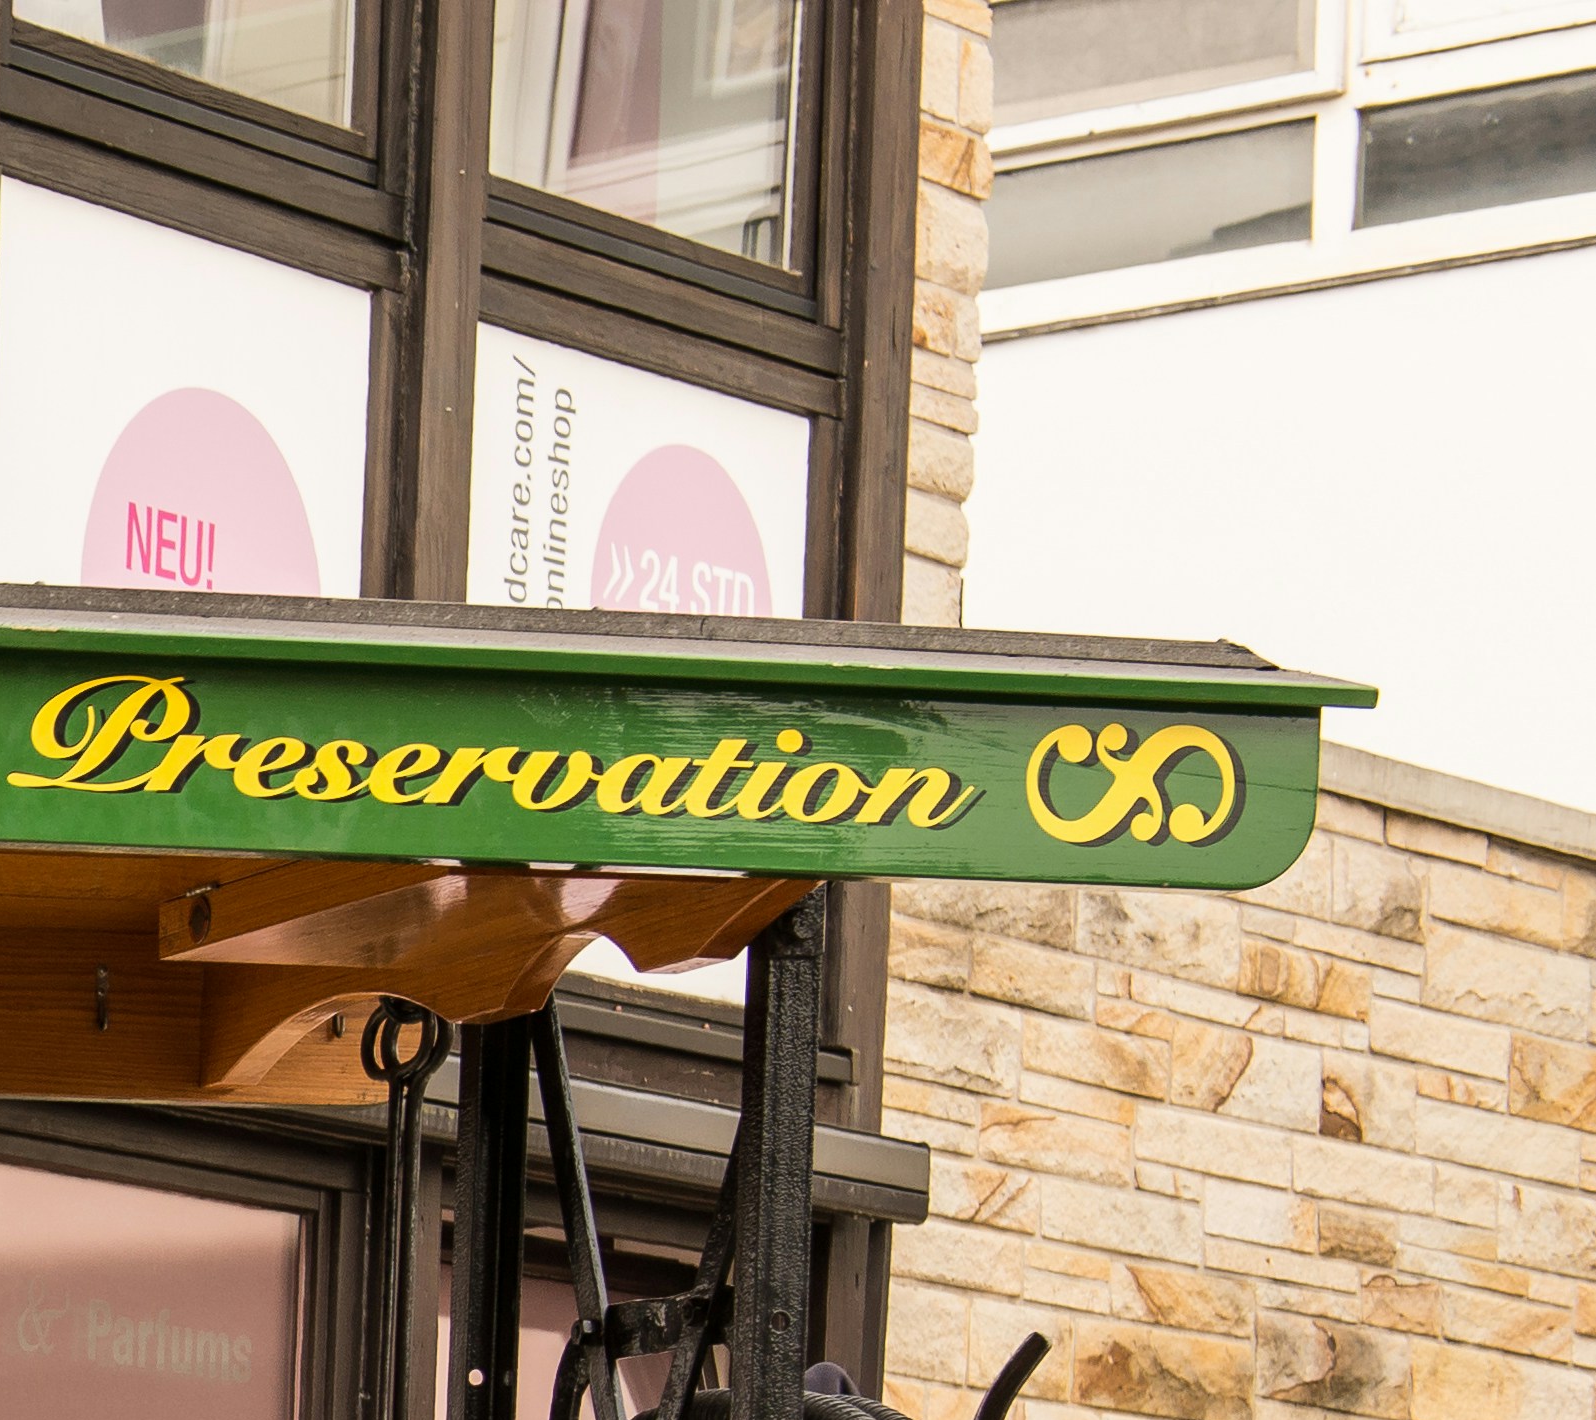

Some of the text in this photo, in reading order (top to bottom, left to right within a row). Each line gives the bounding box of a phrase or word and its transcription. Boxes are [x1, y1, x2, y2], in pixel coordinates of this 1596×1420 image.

[125, 500, 216, 590] NEU!
[639, 548, 680, 614] 24
[8, 674, 979, 830] Preservation
[84, 1299, 254, 1385] Parfums
